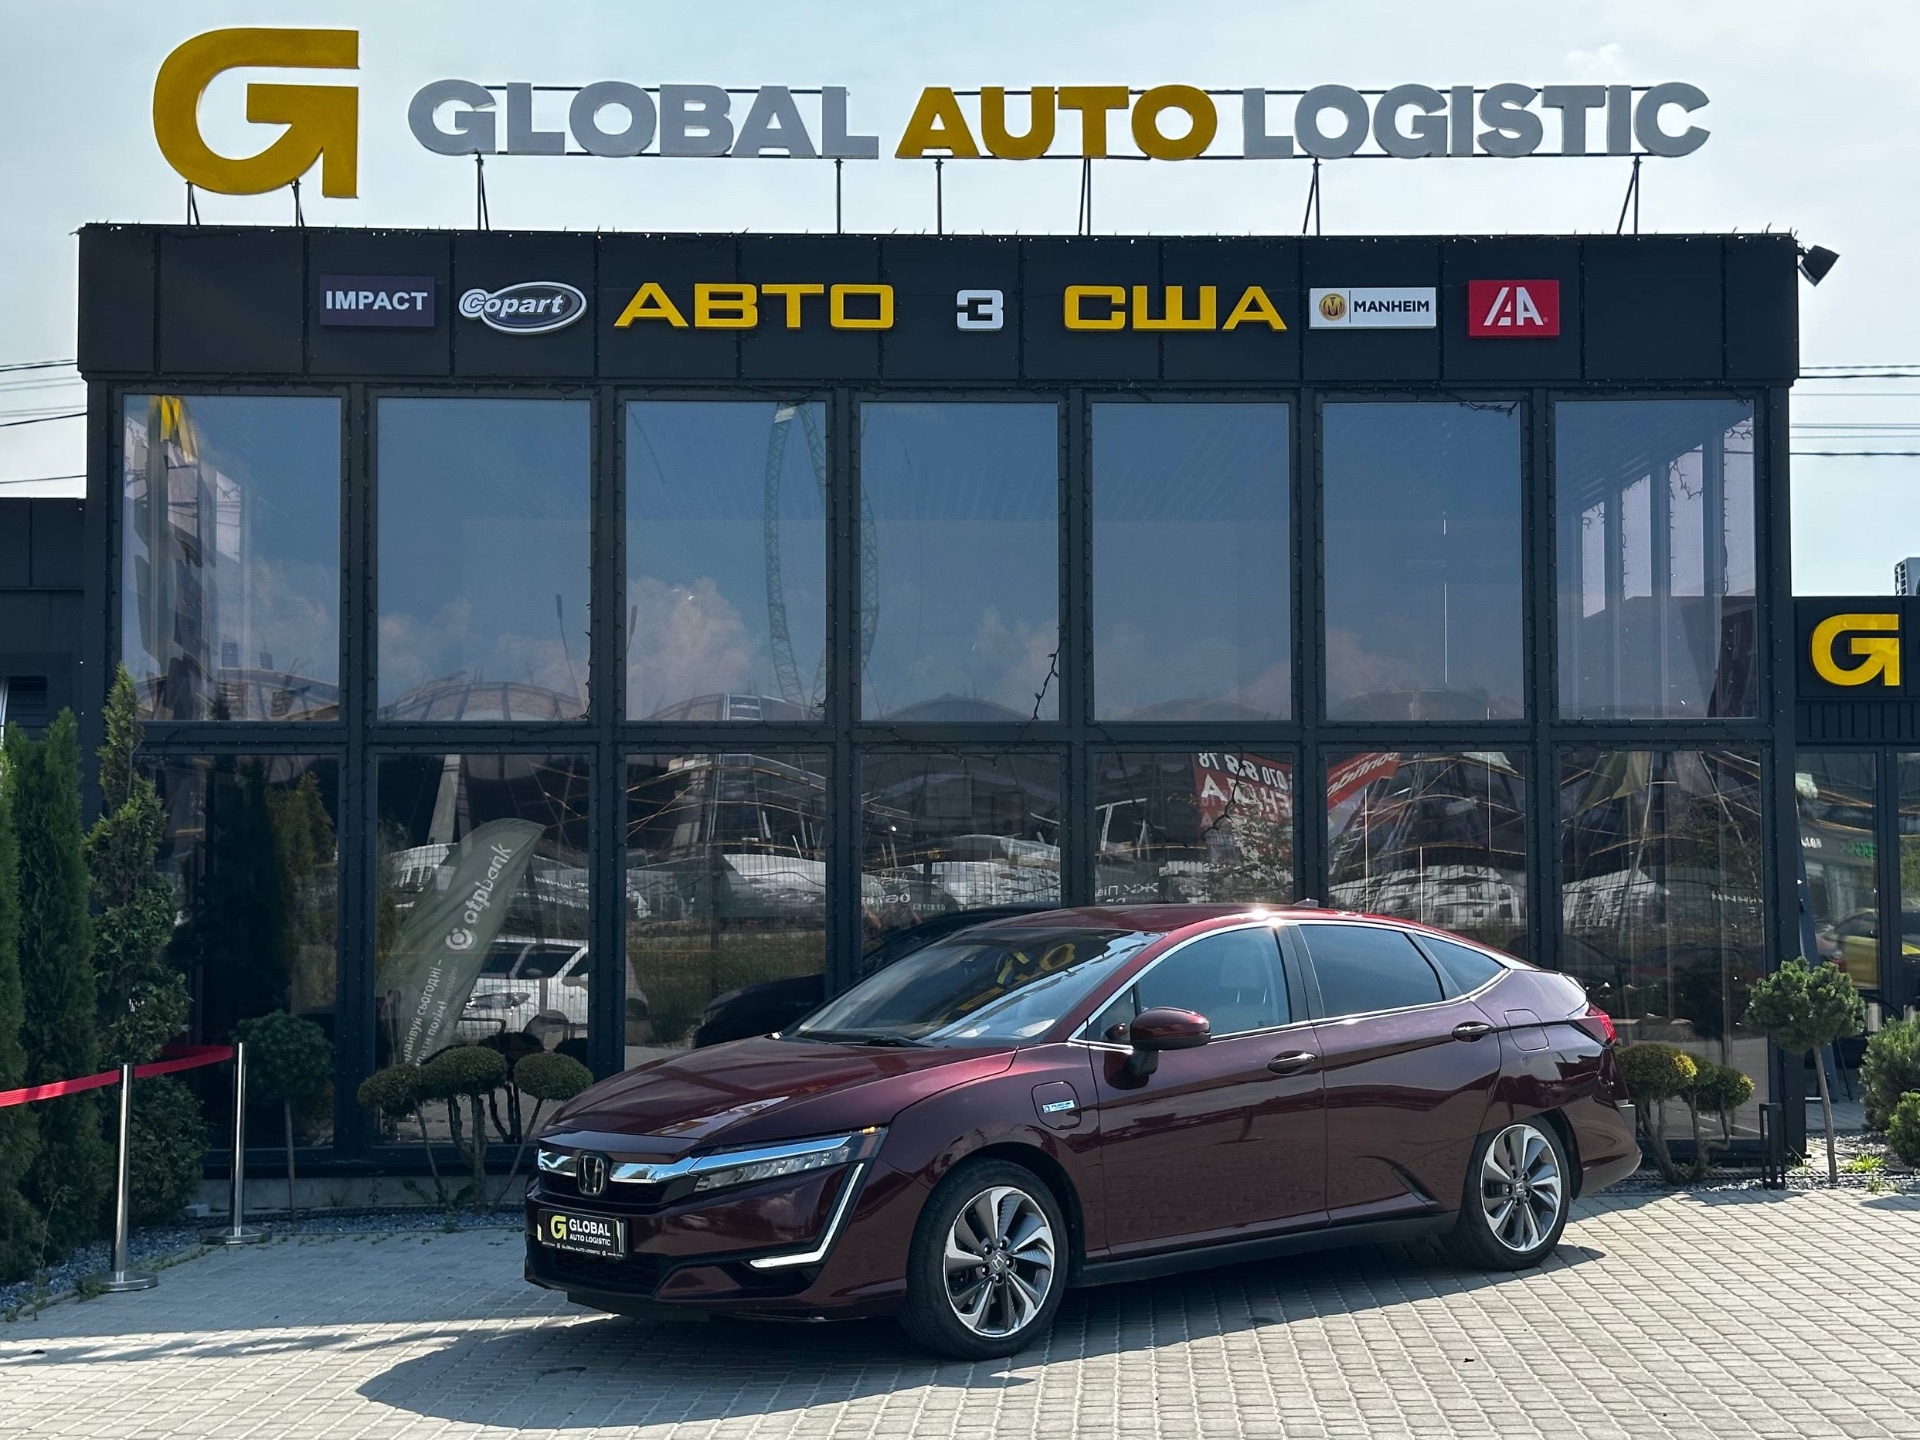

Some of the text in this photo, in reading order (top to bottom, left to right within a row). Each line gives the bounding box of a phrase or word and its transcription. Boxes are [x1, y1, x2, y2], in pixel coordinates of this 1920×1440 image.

[408, 79, 1711, 161] GLOBAL AUTO LOGISTIC
[325, 290, 428, 311] IMPACT
[461, 289, 566, 318] Copart
[614, 283, 894, 330] АВТО
[1064, 285, 1287, 332] США
[1353, 300, 1430, 313] MANHEIM
[464, 843, 512, 924] otpbank
[416, 966, 442, 1016] сьогодні
[568, 1218, 611, 1237] GLOBAL
[569, 1233, 611, 1247] AUTO LOGISTIC
